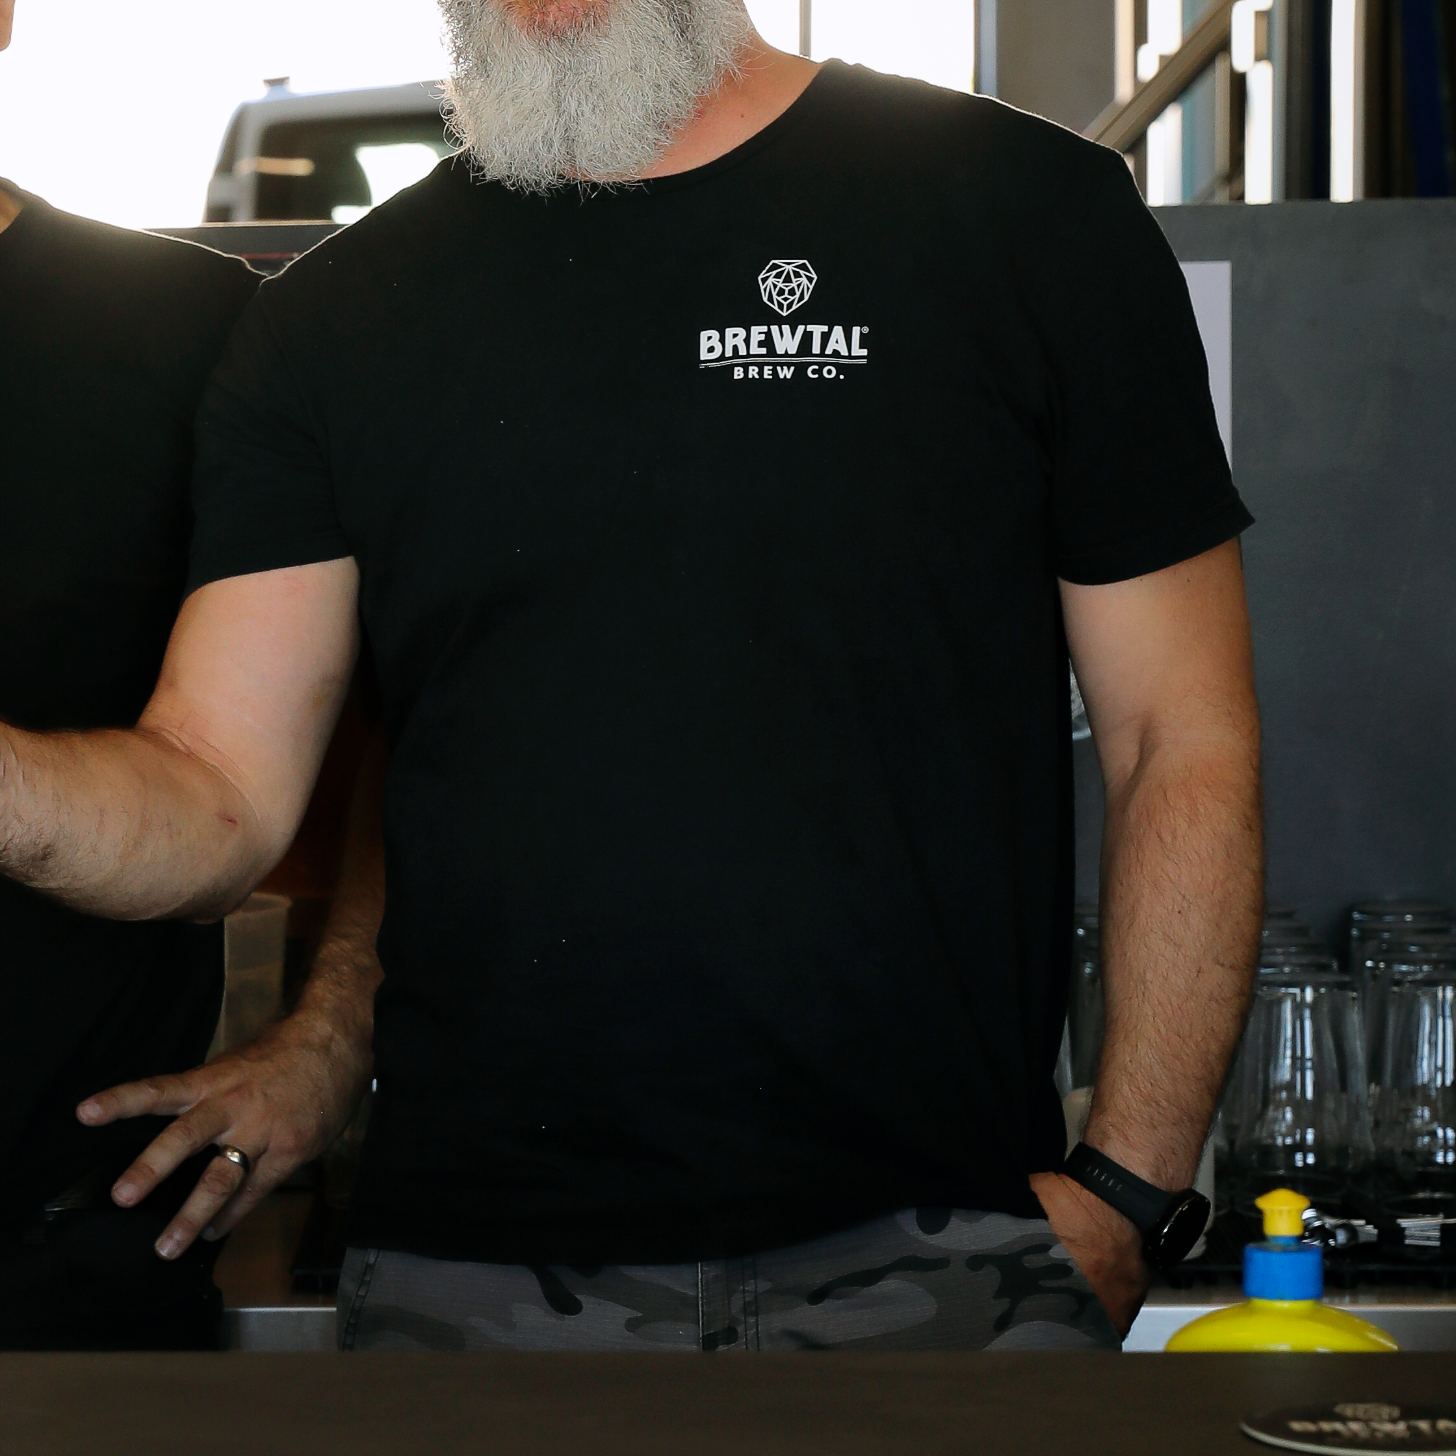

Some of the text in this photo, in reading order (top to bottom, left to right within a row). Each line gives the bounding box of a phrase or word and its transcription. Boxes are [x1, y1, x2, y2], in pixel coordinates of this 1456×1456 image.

[699, 325, 868, 361] BREWTAL
[733, 365, 845, 380] BREW CO.
